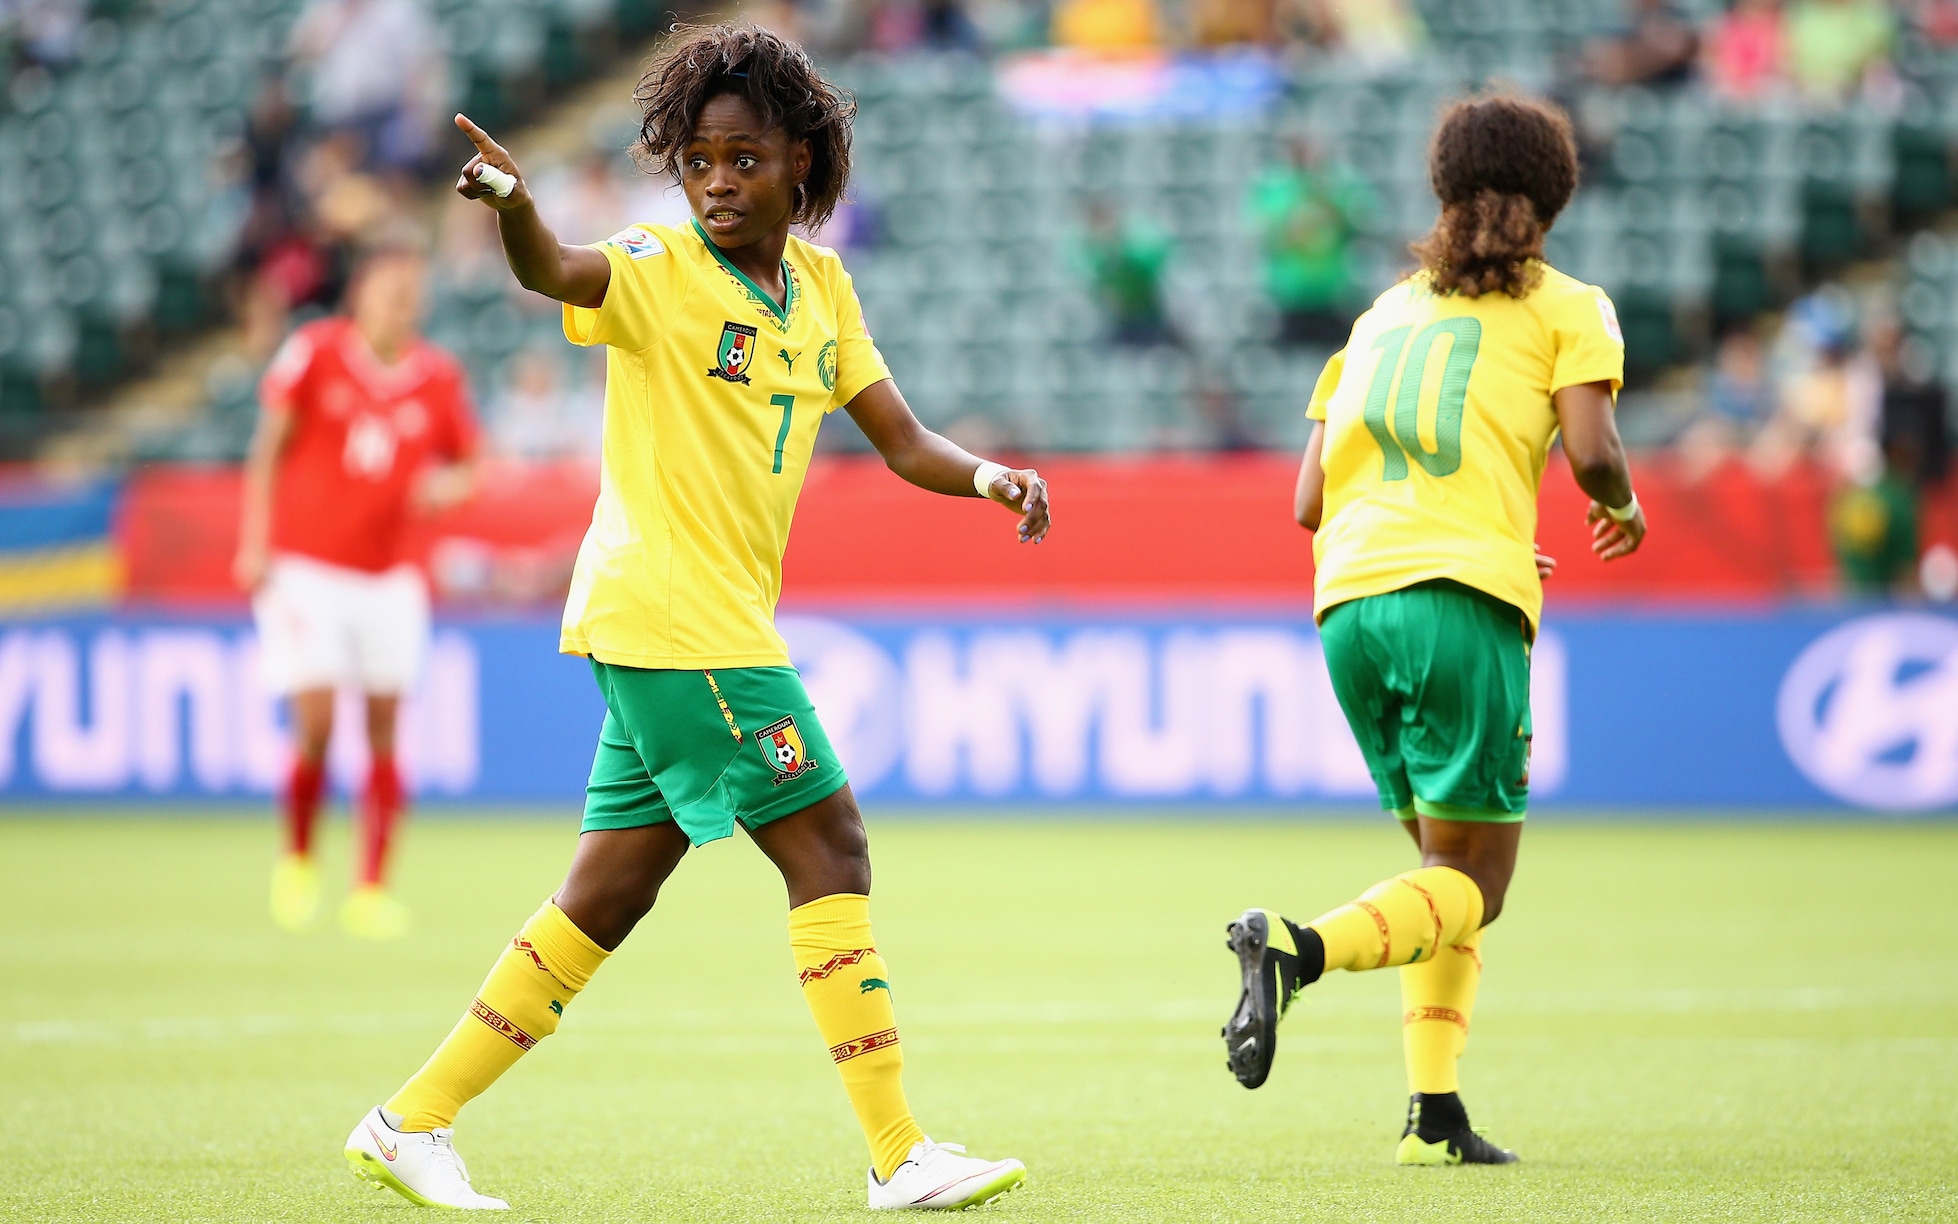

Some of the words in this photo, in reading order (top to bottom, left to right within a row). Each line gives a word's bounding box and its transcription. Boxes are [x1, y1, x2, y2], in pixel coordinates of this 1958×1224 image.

[770, 393, 796, 475] 7
[1364, 316, 1482, 482] 10
[758, 719, 791, 738] CAMEROUN
